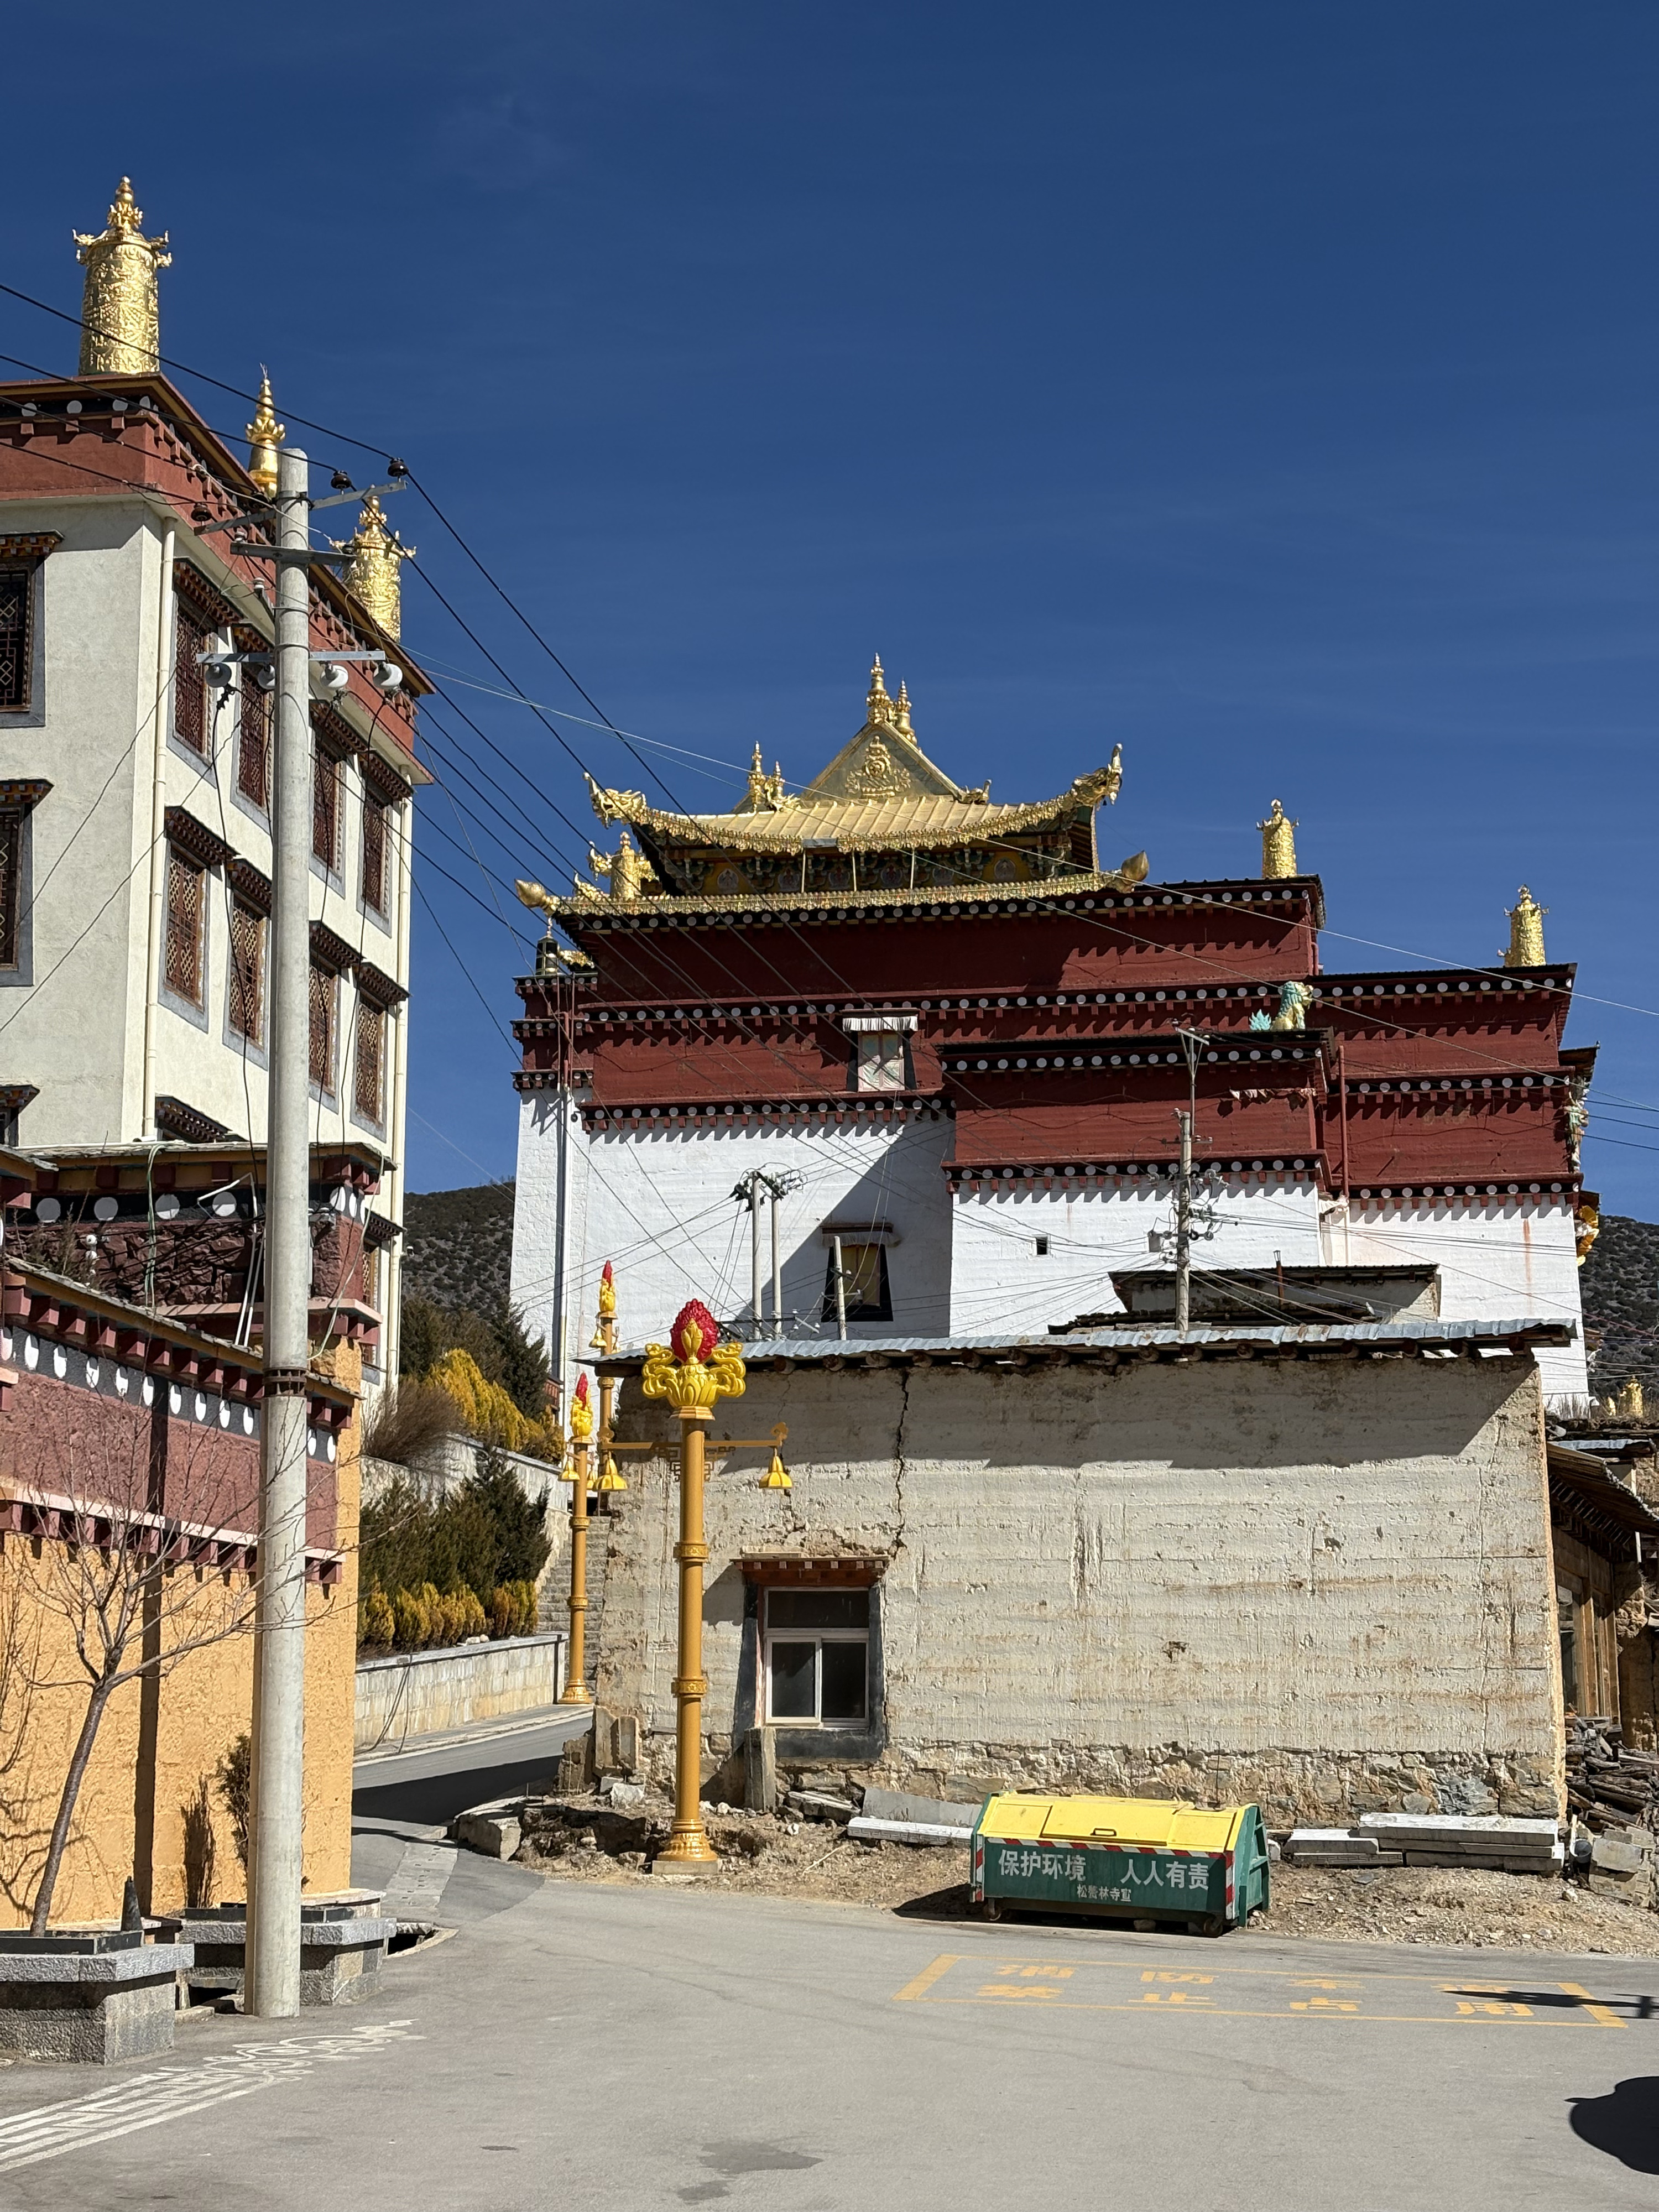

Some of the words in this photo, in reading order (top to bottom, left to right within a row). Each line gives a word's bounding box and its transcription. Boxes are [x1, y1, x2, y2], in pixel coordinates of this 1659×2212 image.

[998, 1849, 1086, 1881] 保护环境
[1120, 1859, 1209, 1890] 人人有责
[976, 1984, 1534, 2017] 禁止占用
